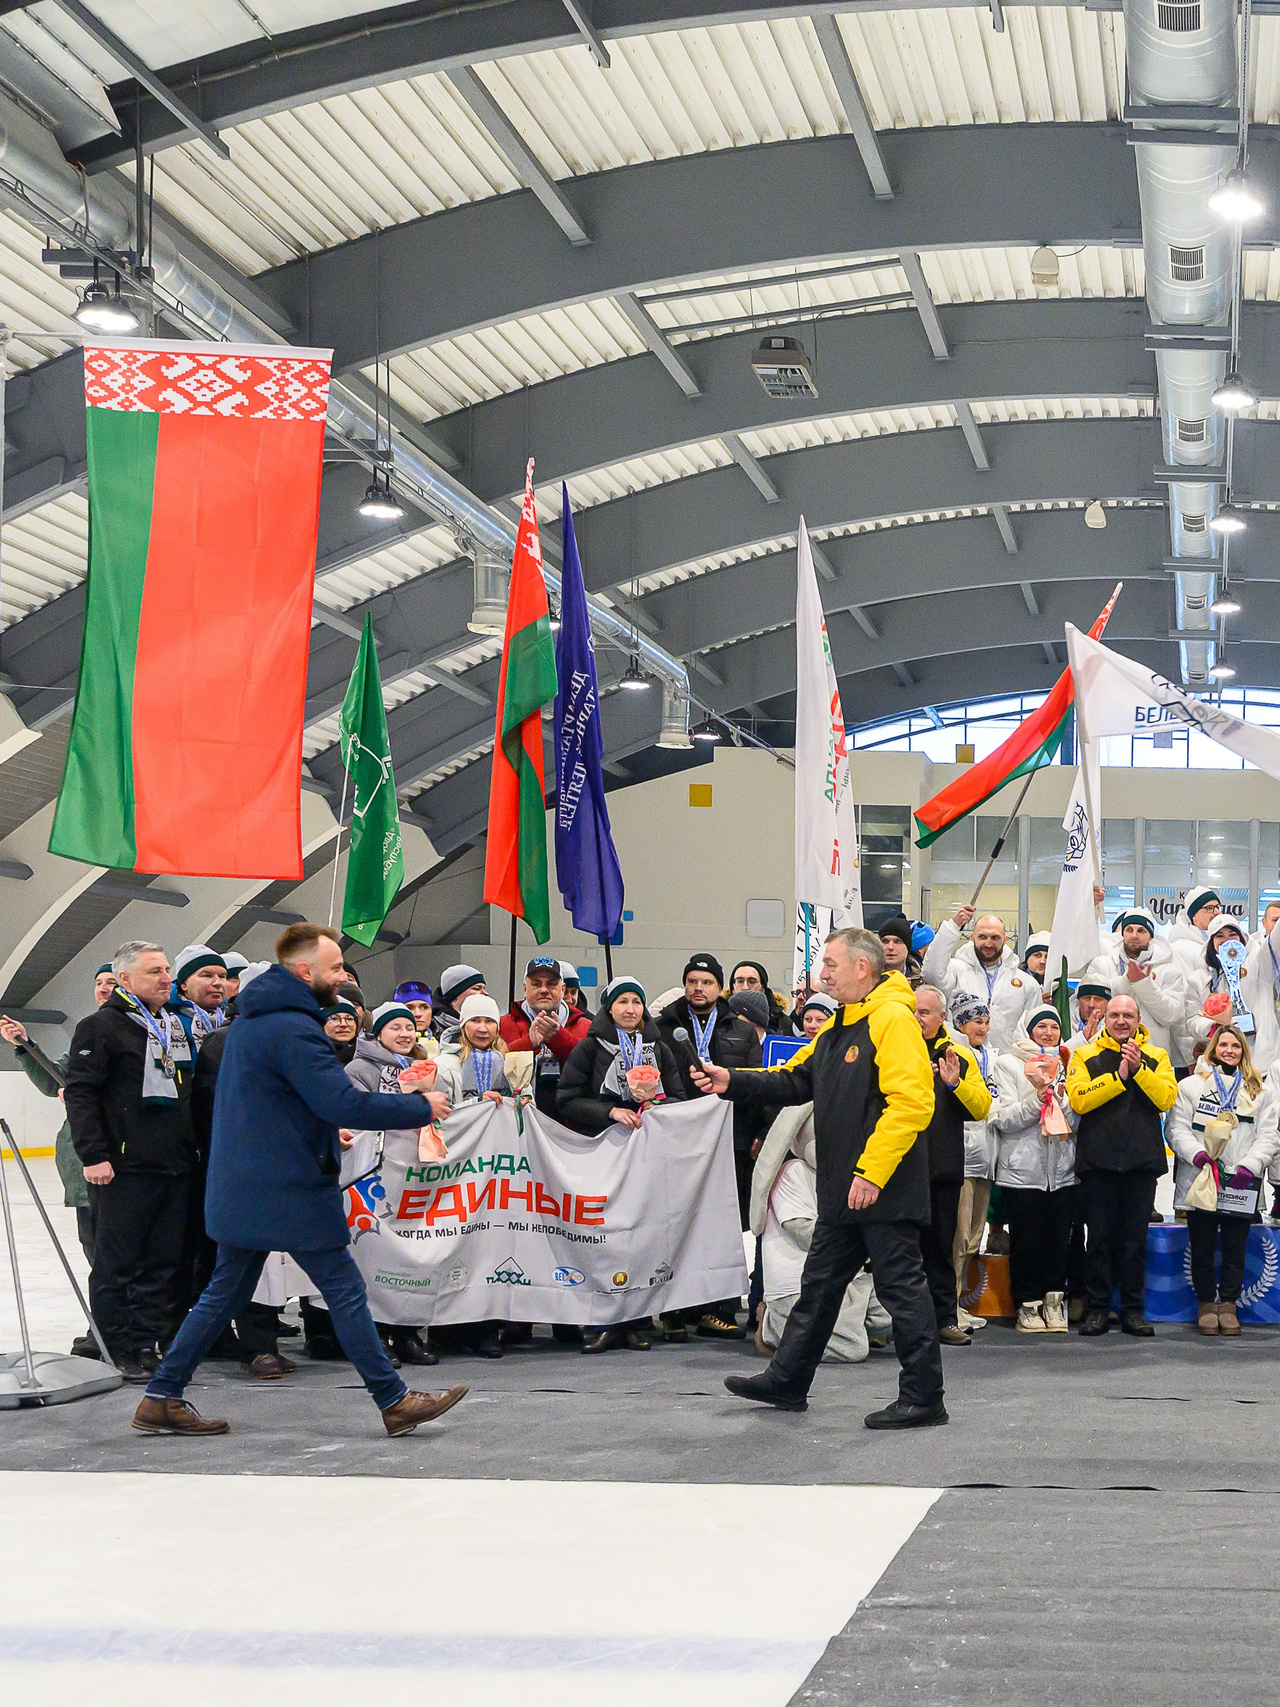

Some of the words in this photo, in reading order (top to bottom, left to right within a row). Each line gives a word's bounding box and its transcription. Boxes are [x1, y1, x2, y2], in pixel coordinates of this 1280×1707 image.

[405, 1154, 531, 1183] КОМАНДА
[396, 1178, 607, 1226] ЕДИНЫЕ
[435, 1227, 457, 1238] МЫ
[460, 1220, 490, 1236] ЕДИНЫ
[508, 1222, 529, 1232] МЫ
[531, 1223, 607, 1245] НЕПОБЕДИМЫ!
[374, 1274, 431, 1288] ВОСТОЧНЫЙ
